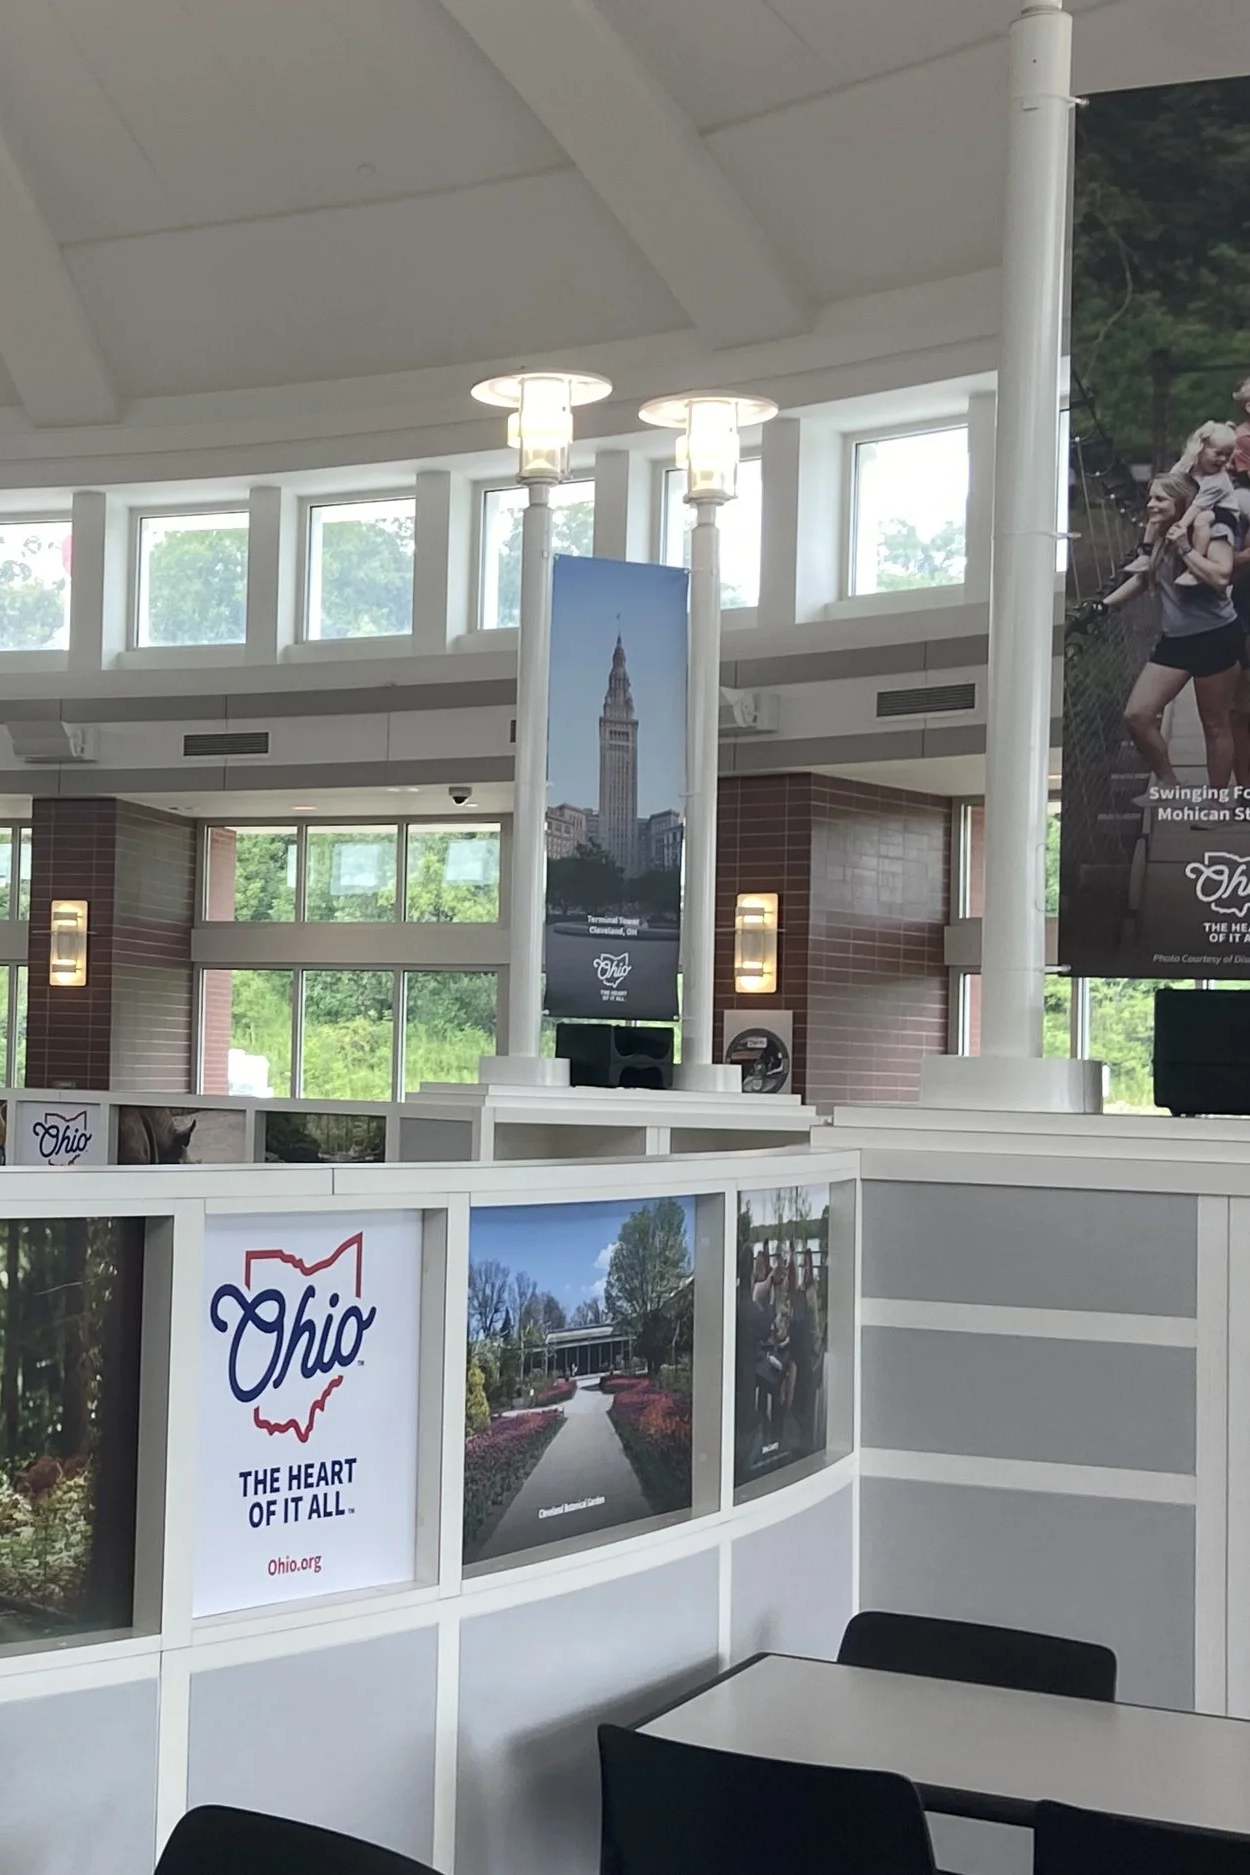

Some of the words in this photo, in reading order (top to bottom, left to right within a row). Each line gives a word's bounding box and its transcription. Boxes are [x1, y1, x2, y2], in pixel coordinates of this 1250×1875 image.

[1149, 786, 1229, 802] Swinging
[1158, 807, 1230, 821] Mohican
[587, 915, 618, 925] Terminal
[619, 916, 640, 926] Tower
[1203, 922, 1228, 932] THE
[1231, 922, 1250, 932] HE
[1209, 933, 1226, 943] OF
[1229, 933, 1241, 943] IT
[1152, 954, 1180, 963] Photo
[1181, 954, 1222, 965] Courtesy
[1223, 954, 1233, 964] of
[593, 958, 632, 980] Ohio
[33, 1122, 93, 1158] Ohio
[210, 1283, 377, 1403] Ohio
[238, 1467, 281, 1497] THE
[288, 1457, 357, 1491] HEART
[249, 1499, 277, 1528] OF
[283, 1496, 303, 1523] IT
[307, 1491, 345, 1520] ALL
[268, 1555, 322, 1576] Ohio.org
